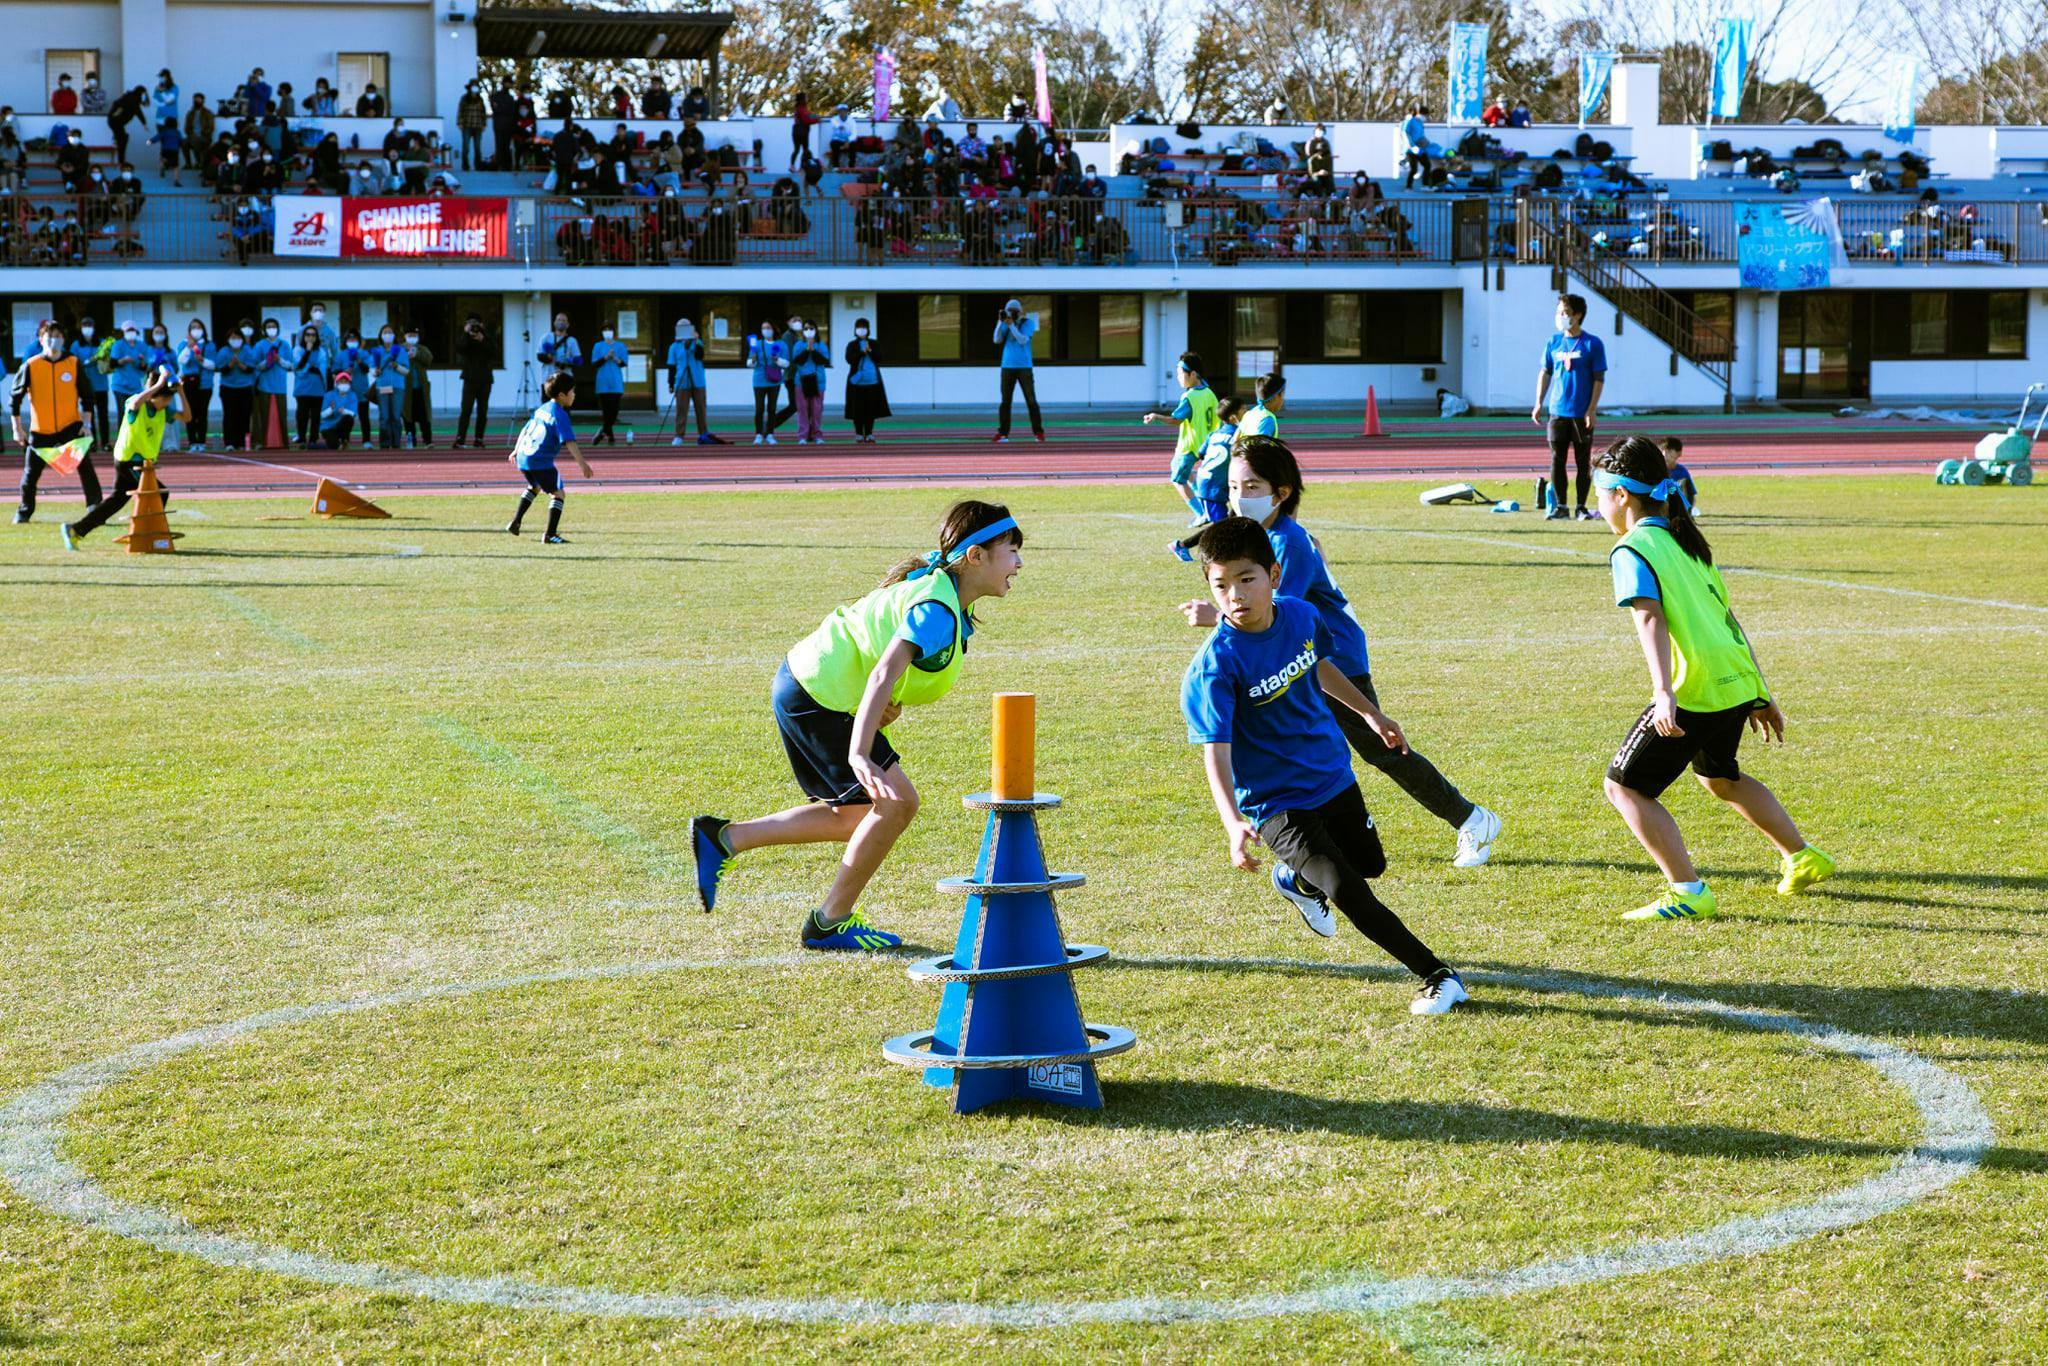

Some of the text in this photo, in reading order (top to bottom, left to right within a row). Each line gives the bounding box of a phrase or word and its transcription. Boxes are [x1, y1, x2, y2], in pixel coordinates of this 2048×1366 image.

[358, 202, 442, 231] CHANGE
[363, 228, 487, 253] & CHALLENGE
